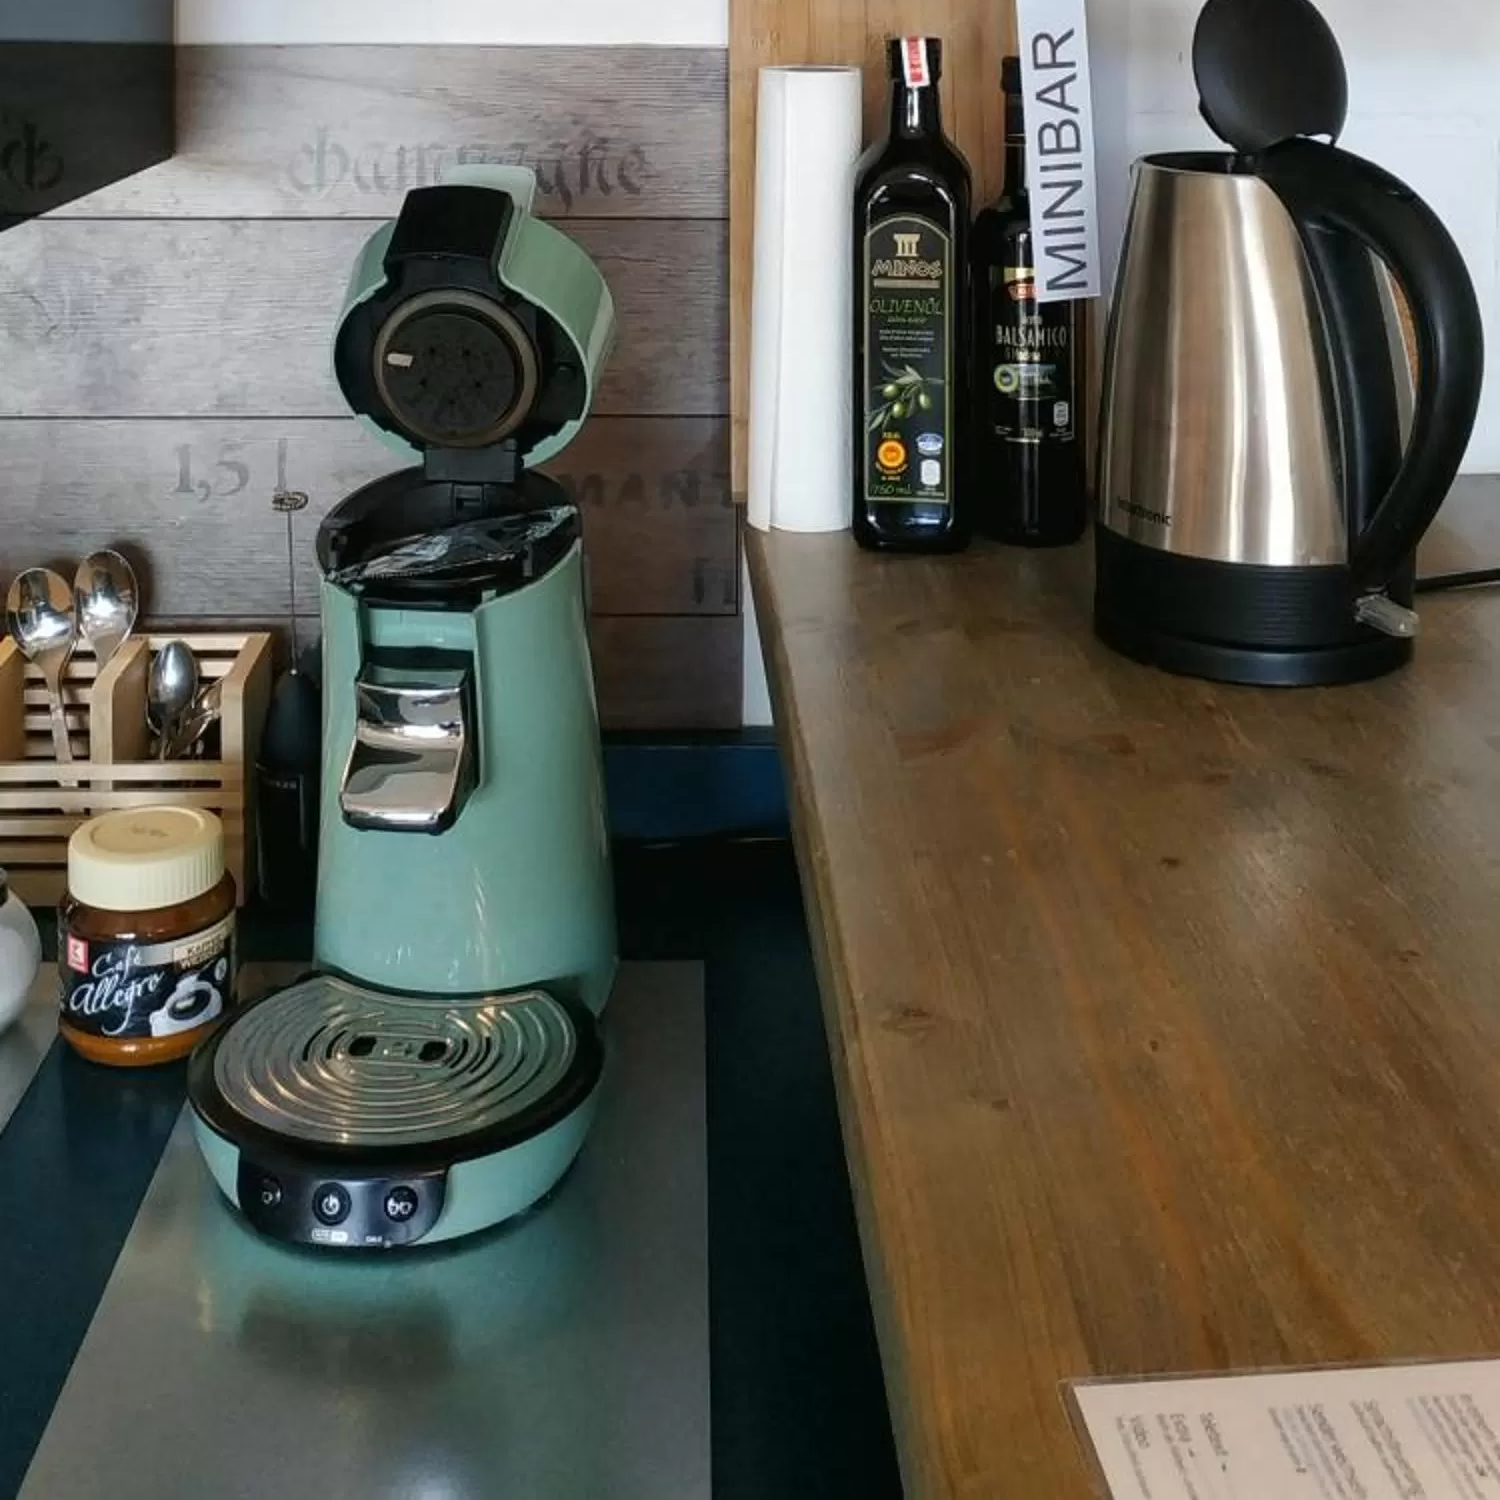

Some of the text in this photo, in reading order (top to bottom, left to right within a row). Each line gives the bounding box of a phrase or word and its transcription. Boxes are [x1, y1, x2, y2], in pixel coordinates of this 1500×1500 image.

[1031, 27, 1089, 292] MINIBAR
[871, 259, 943, 279] MINOS
[995, 324, 1067, 348] BALSAMICO
